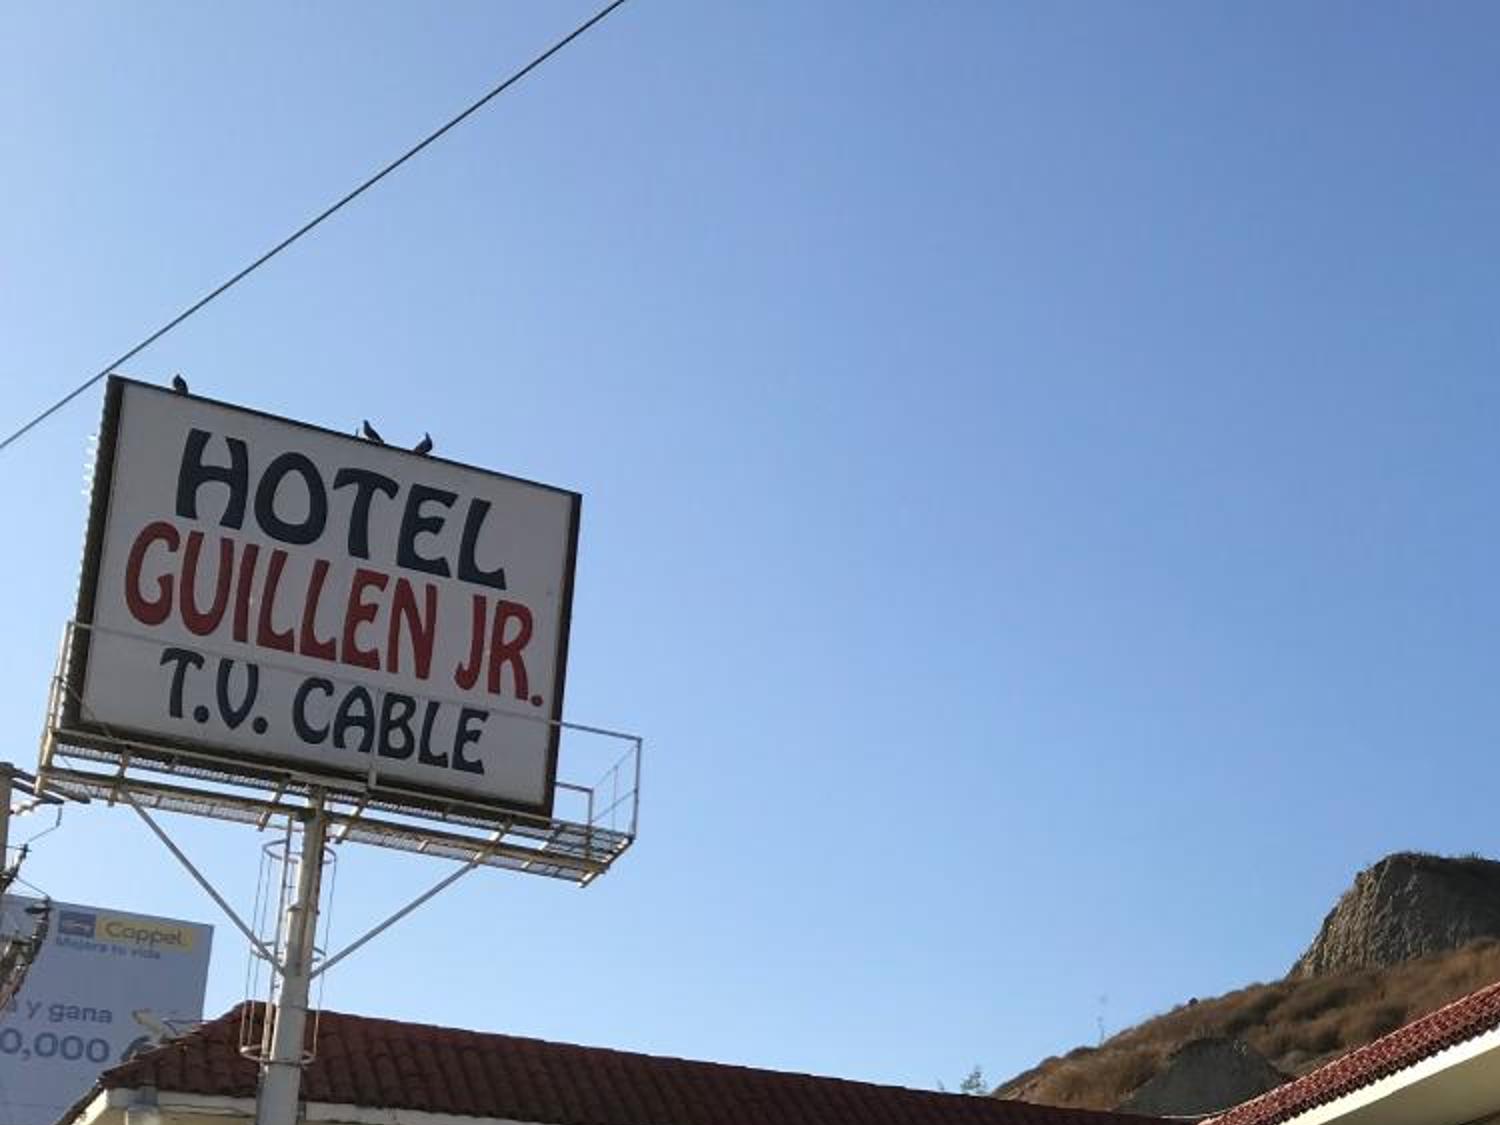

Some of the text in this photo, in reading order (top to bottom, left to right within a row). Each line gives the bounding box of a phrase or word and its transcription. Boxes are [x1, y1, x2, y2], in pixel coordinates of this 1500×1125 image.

[176, 428, 507, 590] HOTEL
[124, 521, 545, 708] GUILLEN JR.
[160, 647, 490, 775] T.V. CABLE
[105, 921, 182, 946] Coppel
[0, 1027, 110, 1064] 0,000
[49, 1004, 113, 1024] gana
